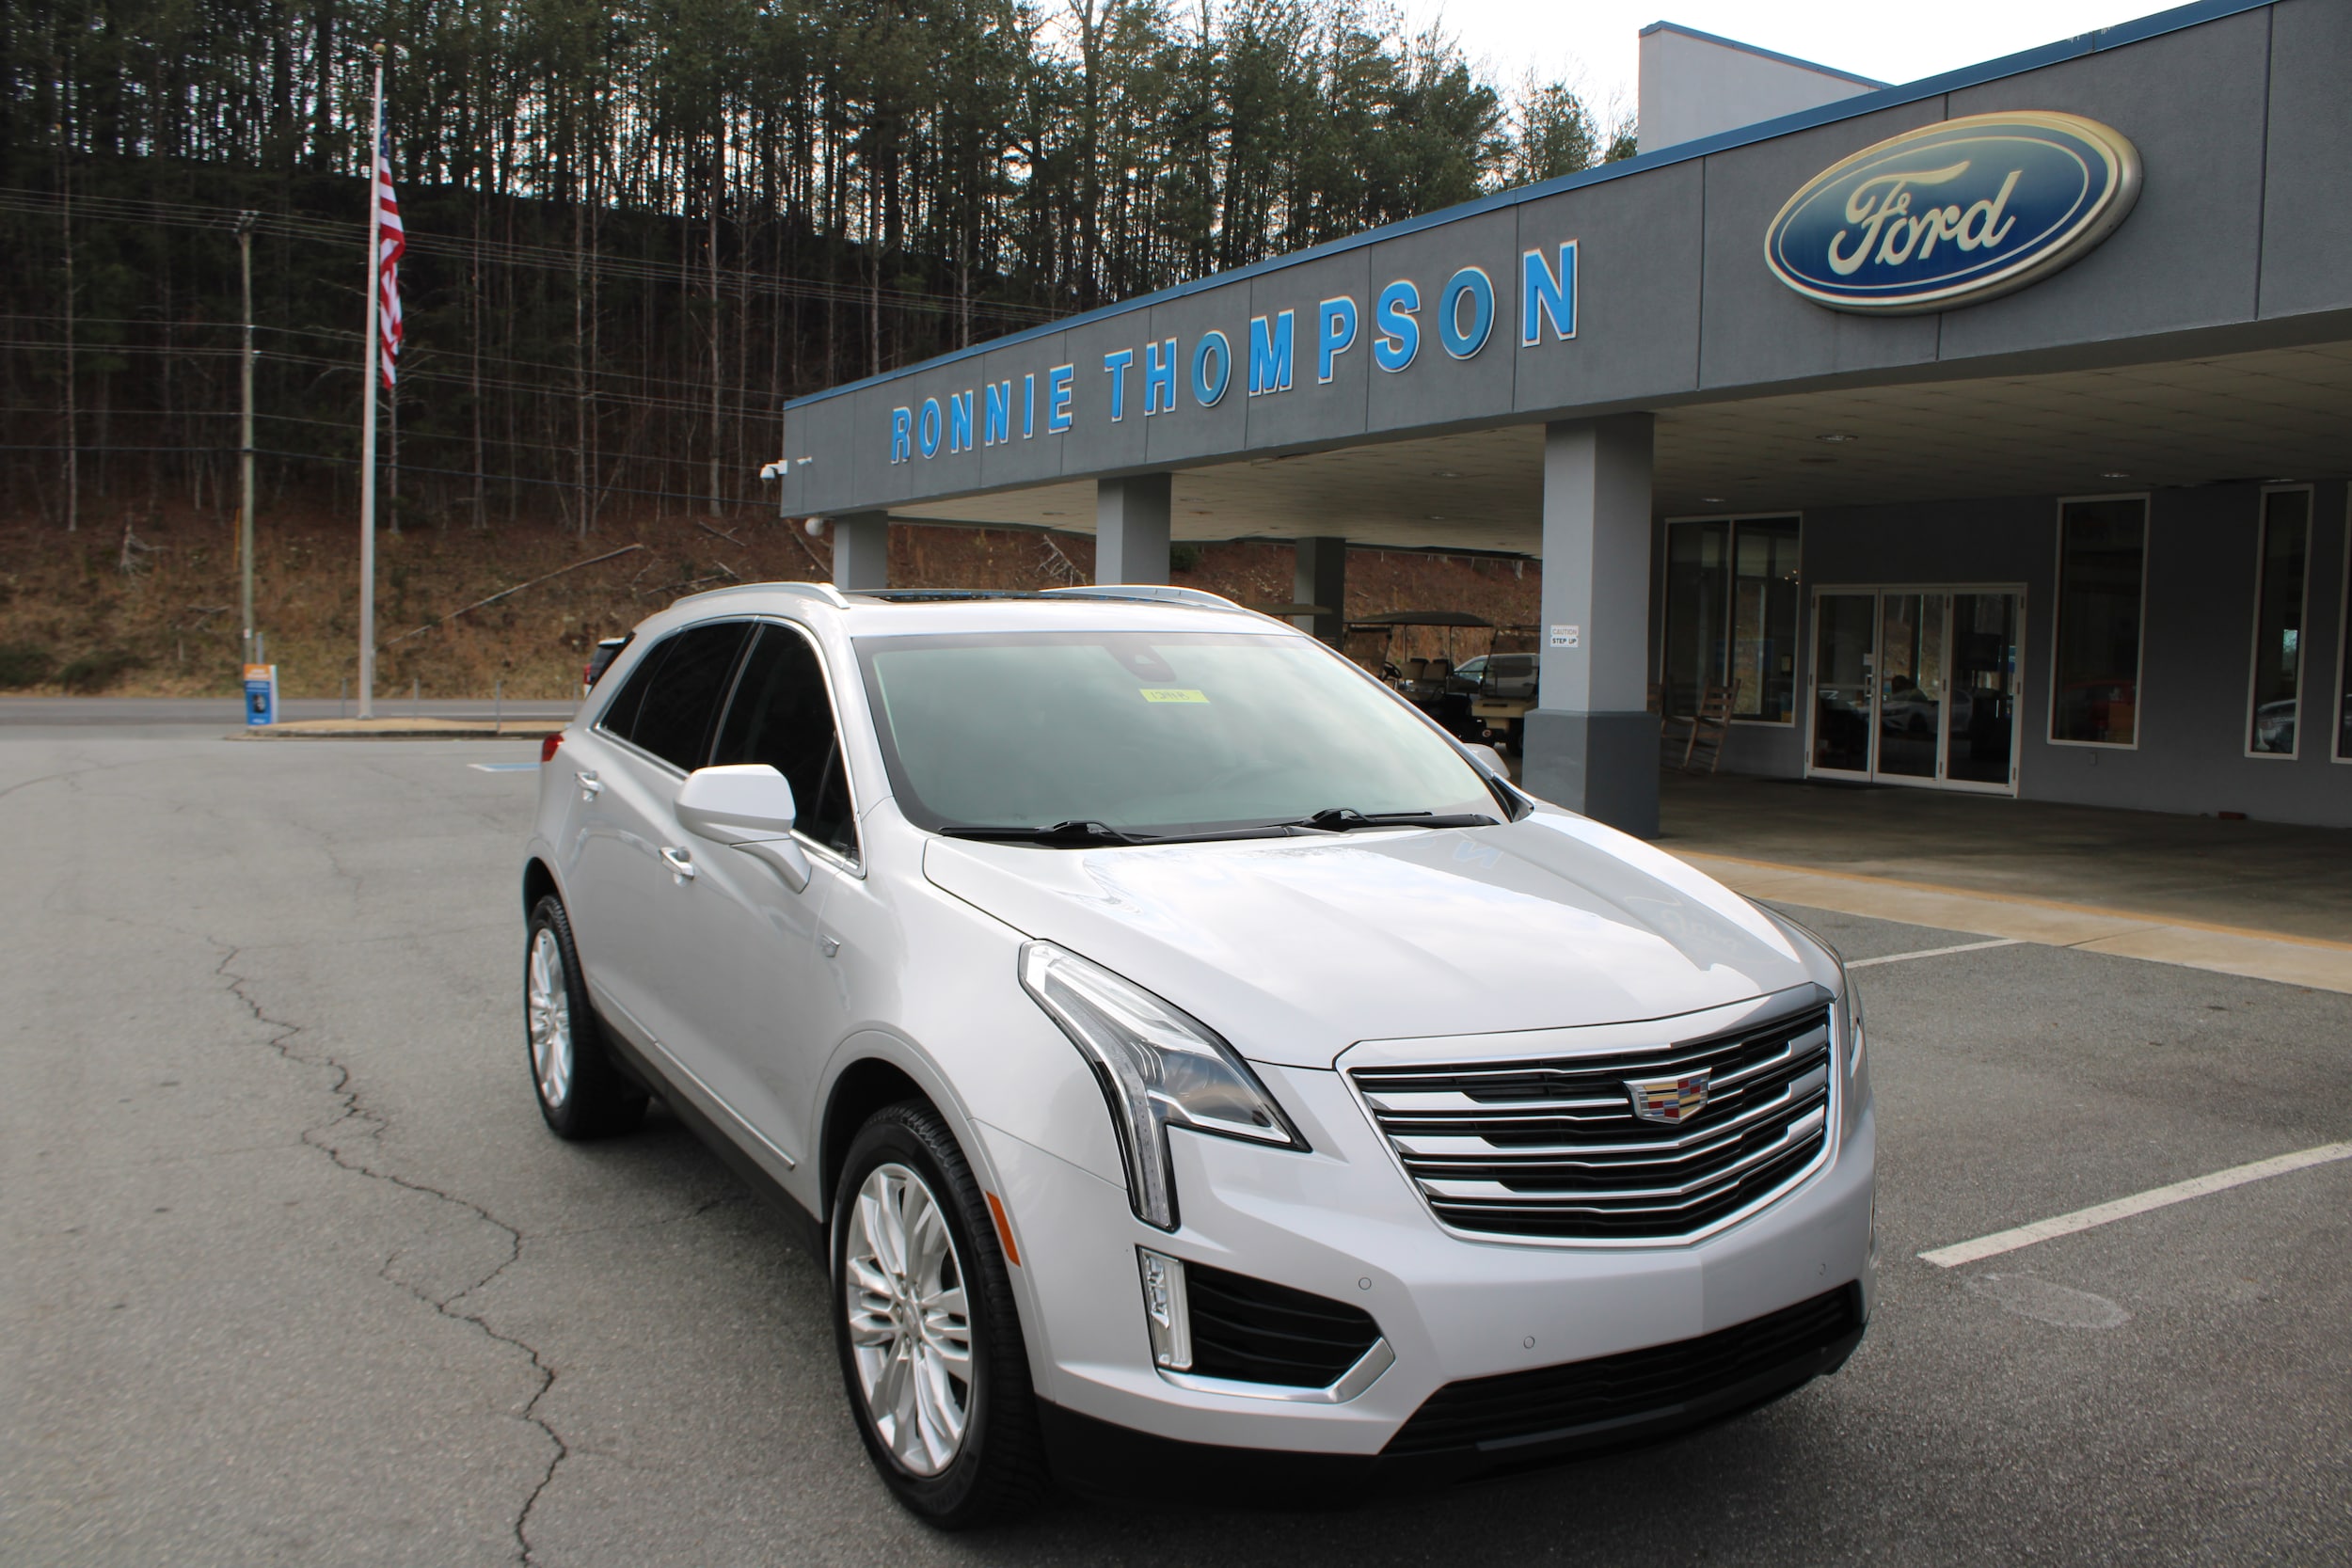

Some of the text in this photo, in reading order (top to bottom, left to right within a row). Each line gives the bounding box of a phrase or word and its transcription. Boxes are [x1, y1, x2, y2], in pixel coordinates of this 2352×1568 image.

[1828, 160, 2024, 276] Ford
[891, 238, 1579, 465] RONNIE THOMPSON
